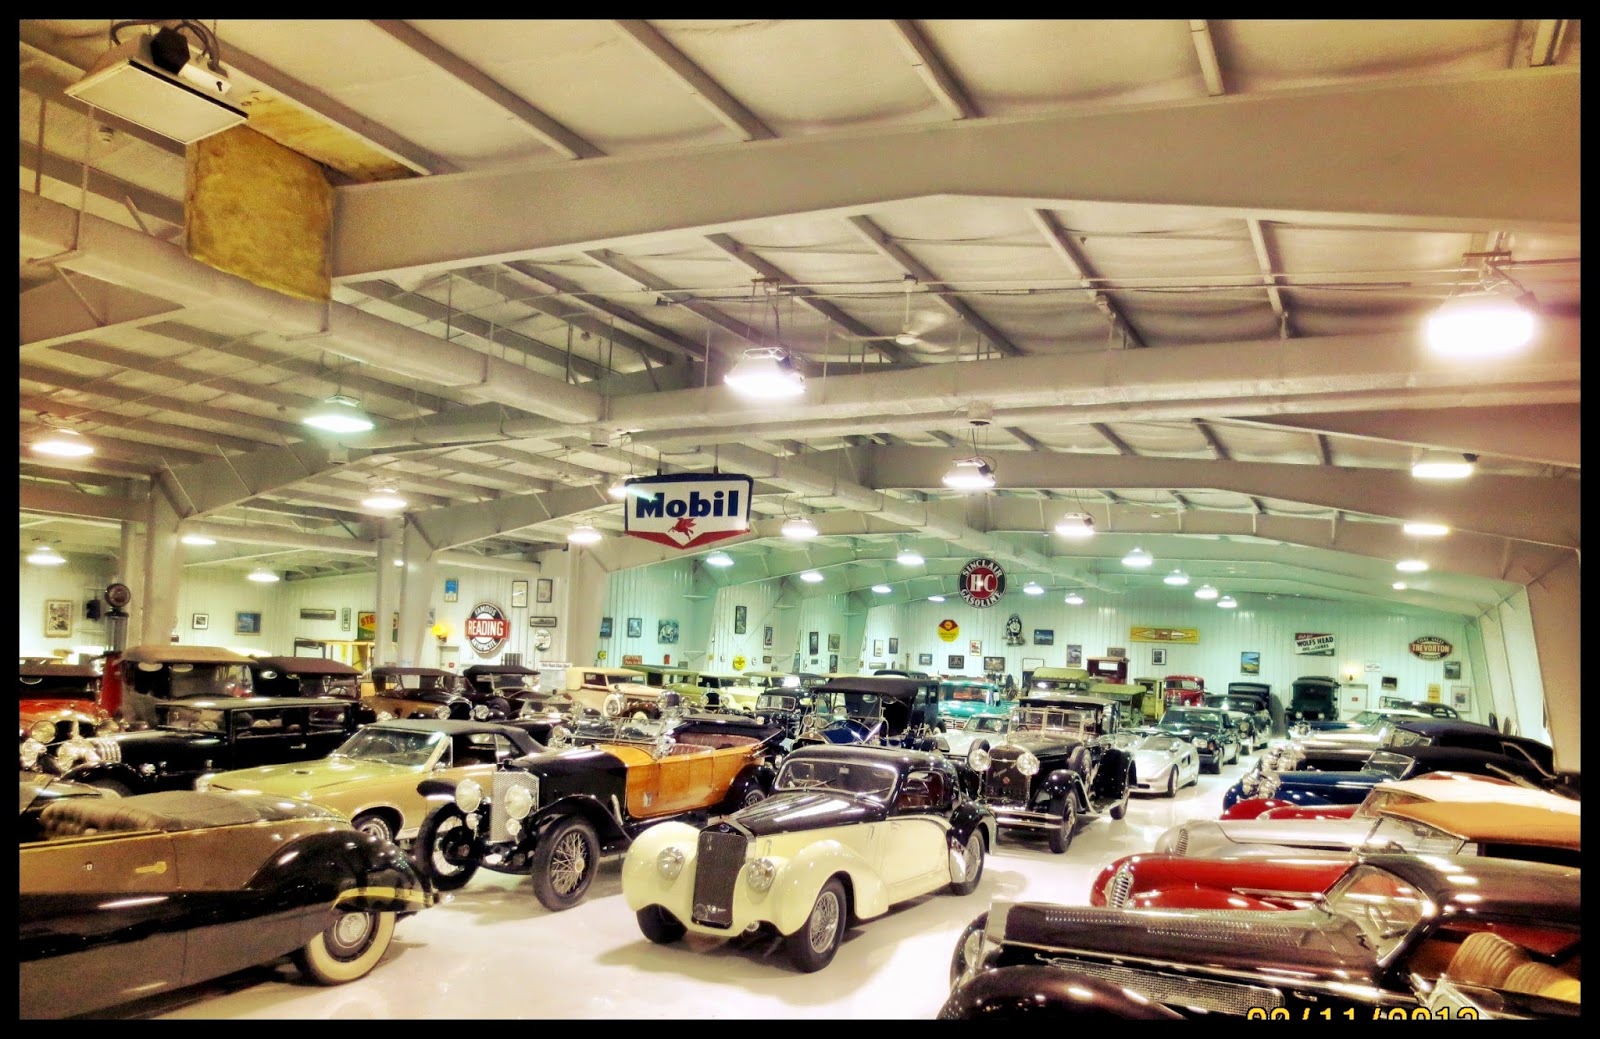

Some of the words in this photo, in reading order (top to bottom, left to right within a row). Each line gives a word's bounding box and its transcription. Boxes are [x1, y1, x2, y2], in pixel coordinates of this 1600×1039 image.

[636, 490, 739, 518] Mobil
[963, 560, 1003, 577] SINCLAIR
[961, 588, 1002, 607] GASOLINE
[474, 605, 497, 617] FAMOUS
[467, 620, 504, 637] READING
[1317, 636, 1334, 644] HEAD
[1411, 644, 1450, 653] TREVORTON
